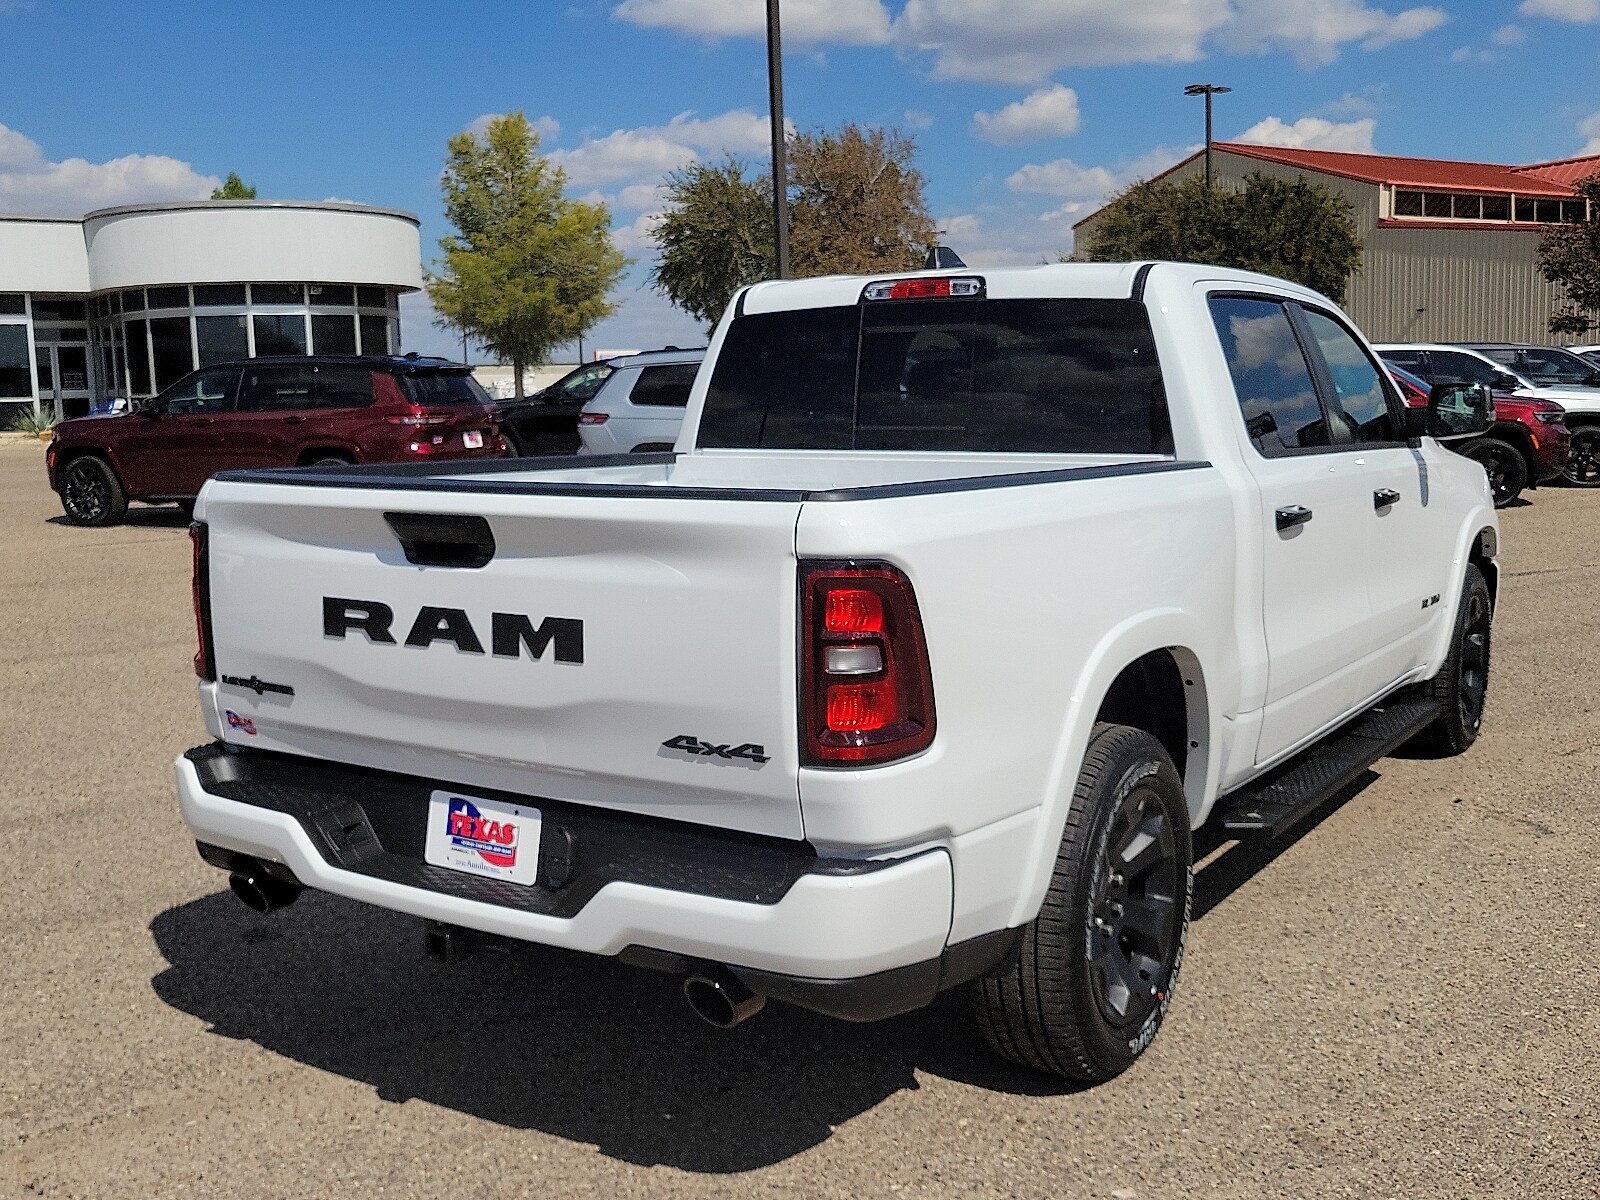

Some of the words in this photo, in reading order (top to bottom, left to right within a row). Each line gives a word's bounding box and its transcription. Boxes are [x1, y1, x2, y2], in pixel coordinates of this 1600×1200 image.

[322, 596, 585, 664] RAM
[661, 734, 770, 762] 4x4
[449, 811, 516, 846] TEXAS
